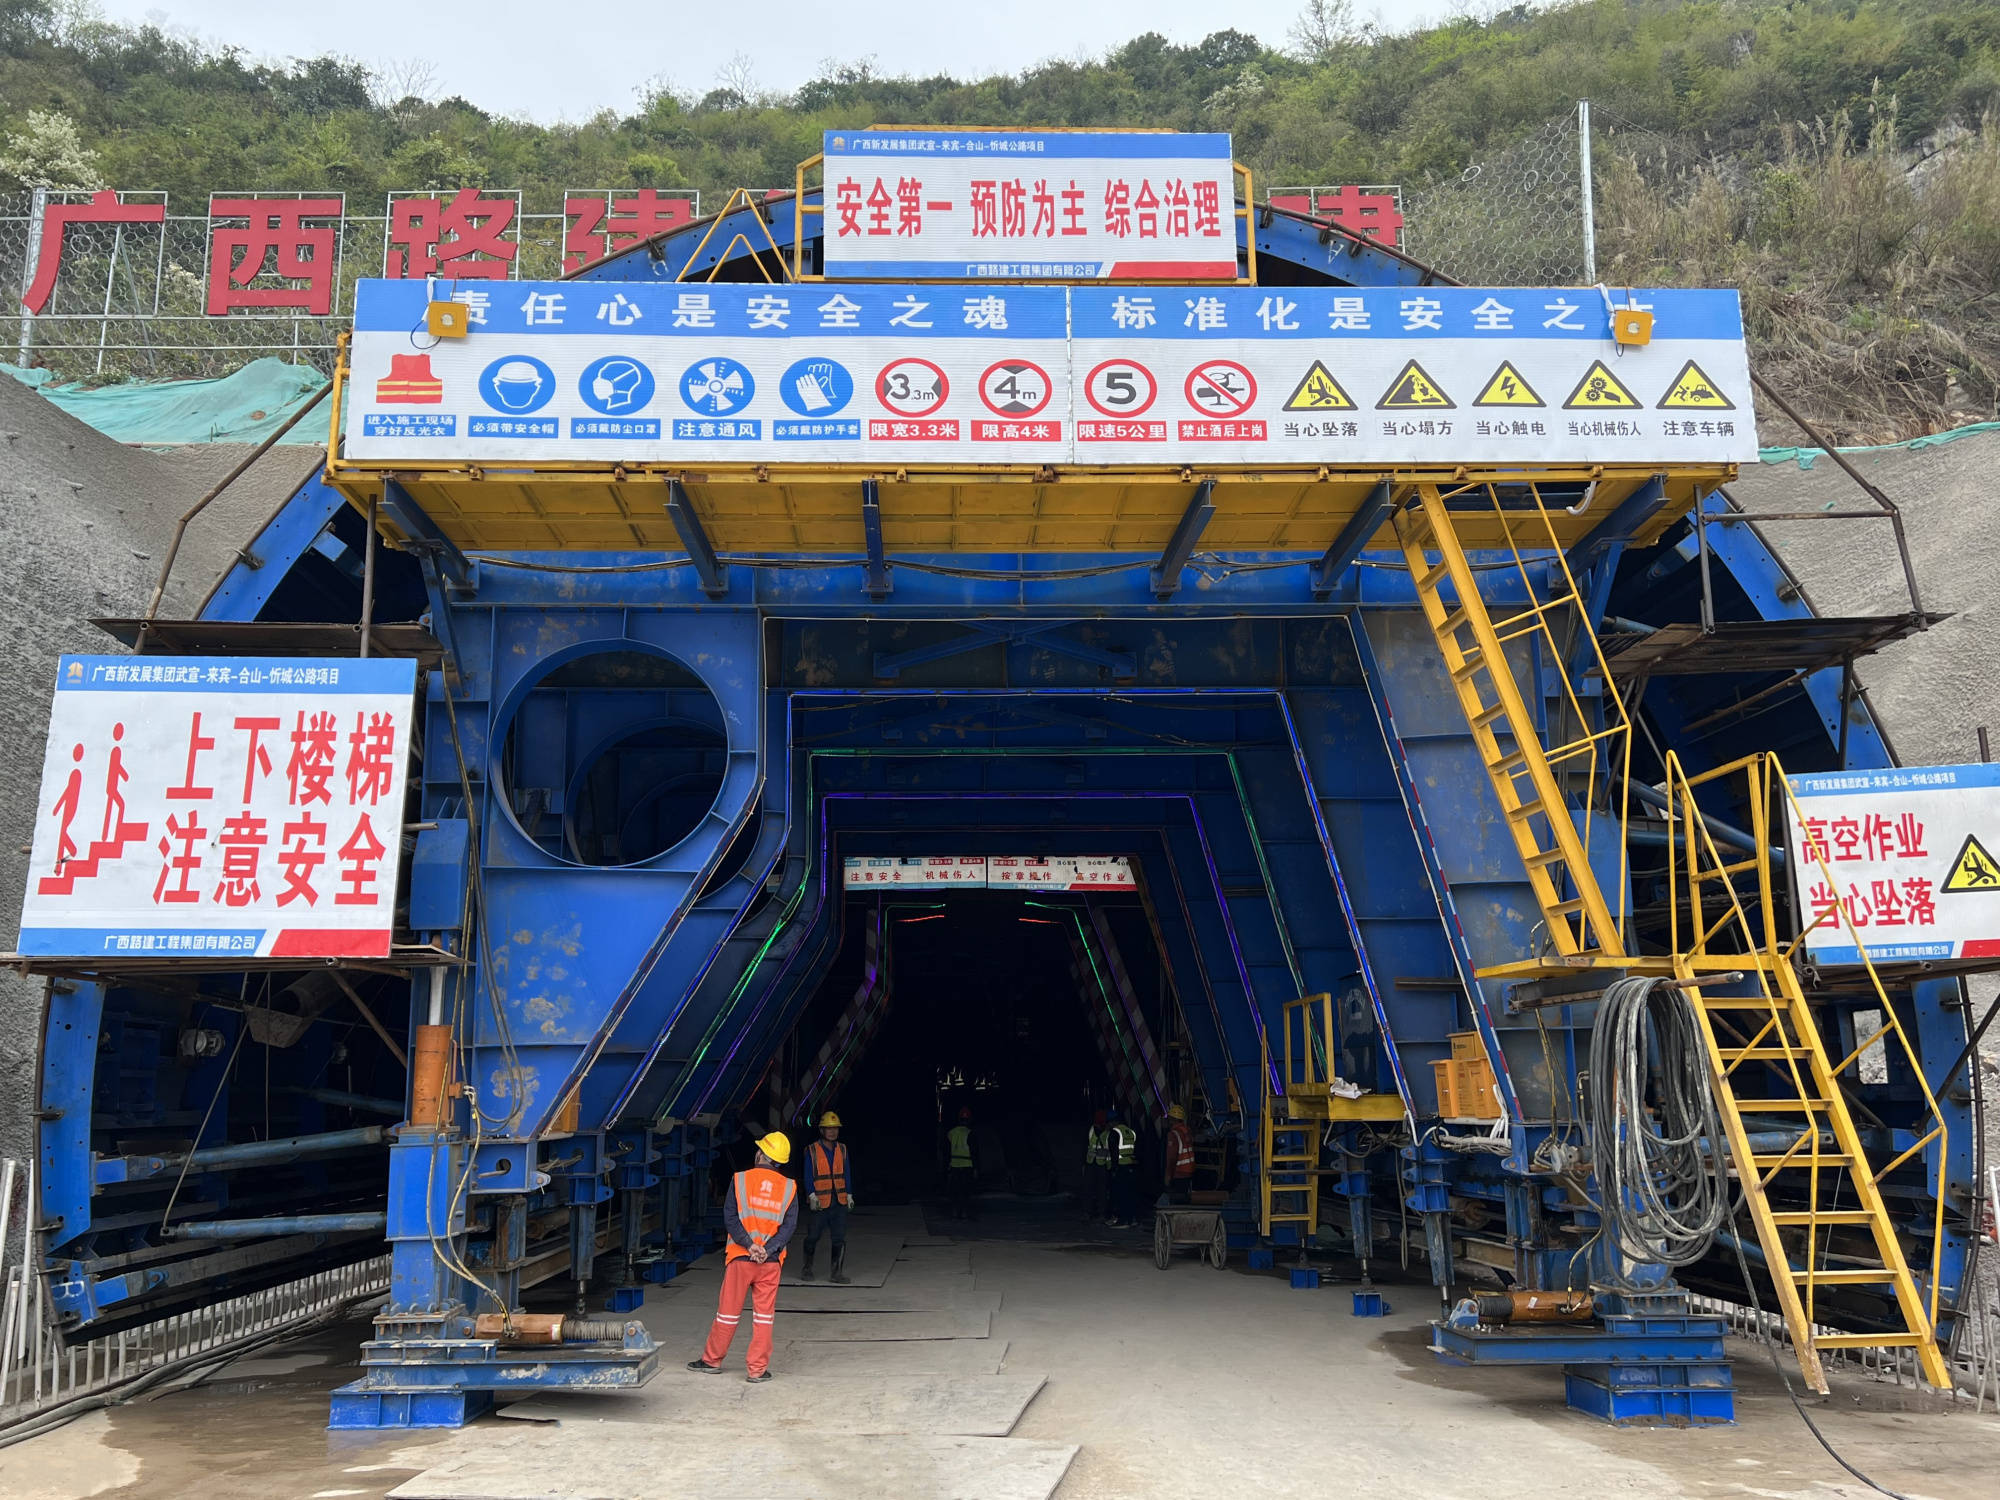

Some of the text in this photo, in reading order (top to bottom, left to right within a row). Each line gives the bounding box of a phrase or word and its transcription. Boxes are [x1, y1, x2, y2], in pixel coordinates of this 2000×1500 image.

[837, 176, 1222, 239] 安全第一 预防为主 综合治理
[966, 263, 1096, 277] 广西路建工程集团有限公司
[449, 289, 1657, 332] 责任心是安全之魂 标准化是安全之
[1105, 372, 1137, 405] 5
[367, 415, 454, 425] 进入施工现场
[1476, 420, 1546, 436] 当心触电
[374, 425, 446, 436] 穿好反光衣
[472, 422, 555, 435] 必须带安全帽
[575, 423, 656, 435] 必须戴防尘口罩
[678, 421, 756, 437] 注意通风
[776, 424, 859, 436] 必须戴防护手套
[871, 422, 957, 438] 限宽3.3米
[982, 423, 1050, 439] 限高4米
[1079, 424, 1166, 439] 限速5公里
[1182, 424, 1263, 438] 禁止酒后上岗
[1284, 422, 1359, 437] 当心坠落
[1382, 421, 1453, 436] 当心塌方
[1567, 420, 1642, 437] 当心机械伤人
[1663, 420, 1735, 437] 注意车辆
[91, 664, 340, 685] 广西新发展集团武宣-来宾-合山-忻城公路项目
[165, 710, 395, 806] 上下楼梯
[1797, 812, 1928, 865] 高空作业
[152, 809, 386, 908] 注意安全
[851, 870, 976, 881] 注意安全 机械伤人
[1001, 871, 1126, 882] 按章操作 高空作业
[1809, 876, 1936, 930] 当心坠落
[103, 934, 256, 951] 广西路建工程集团有限公司
